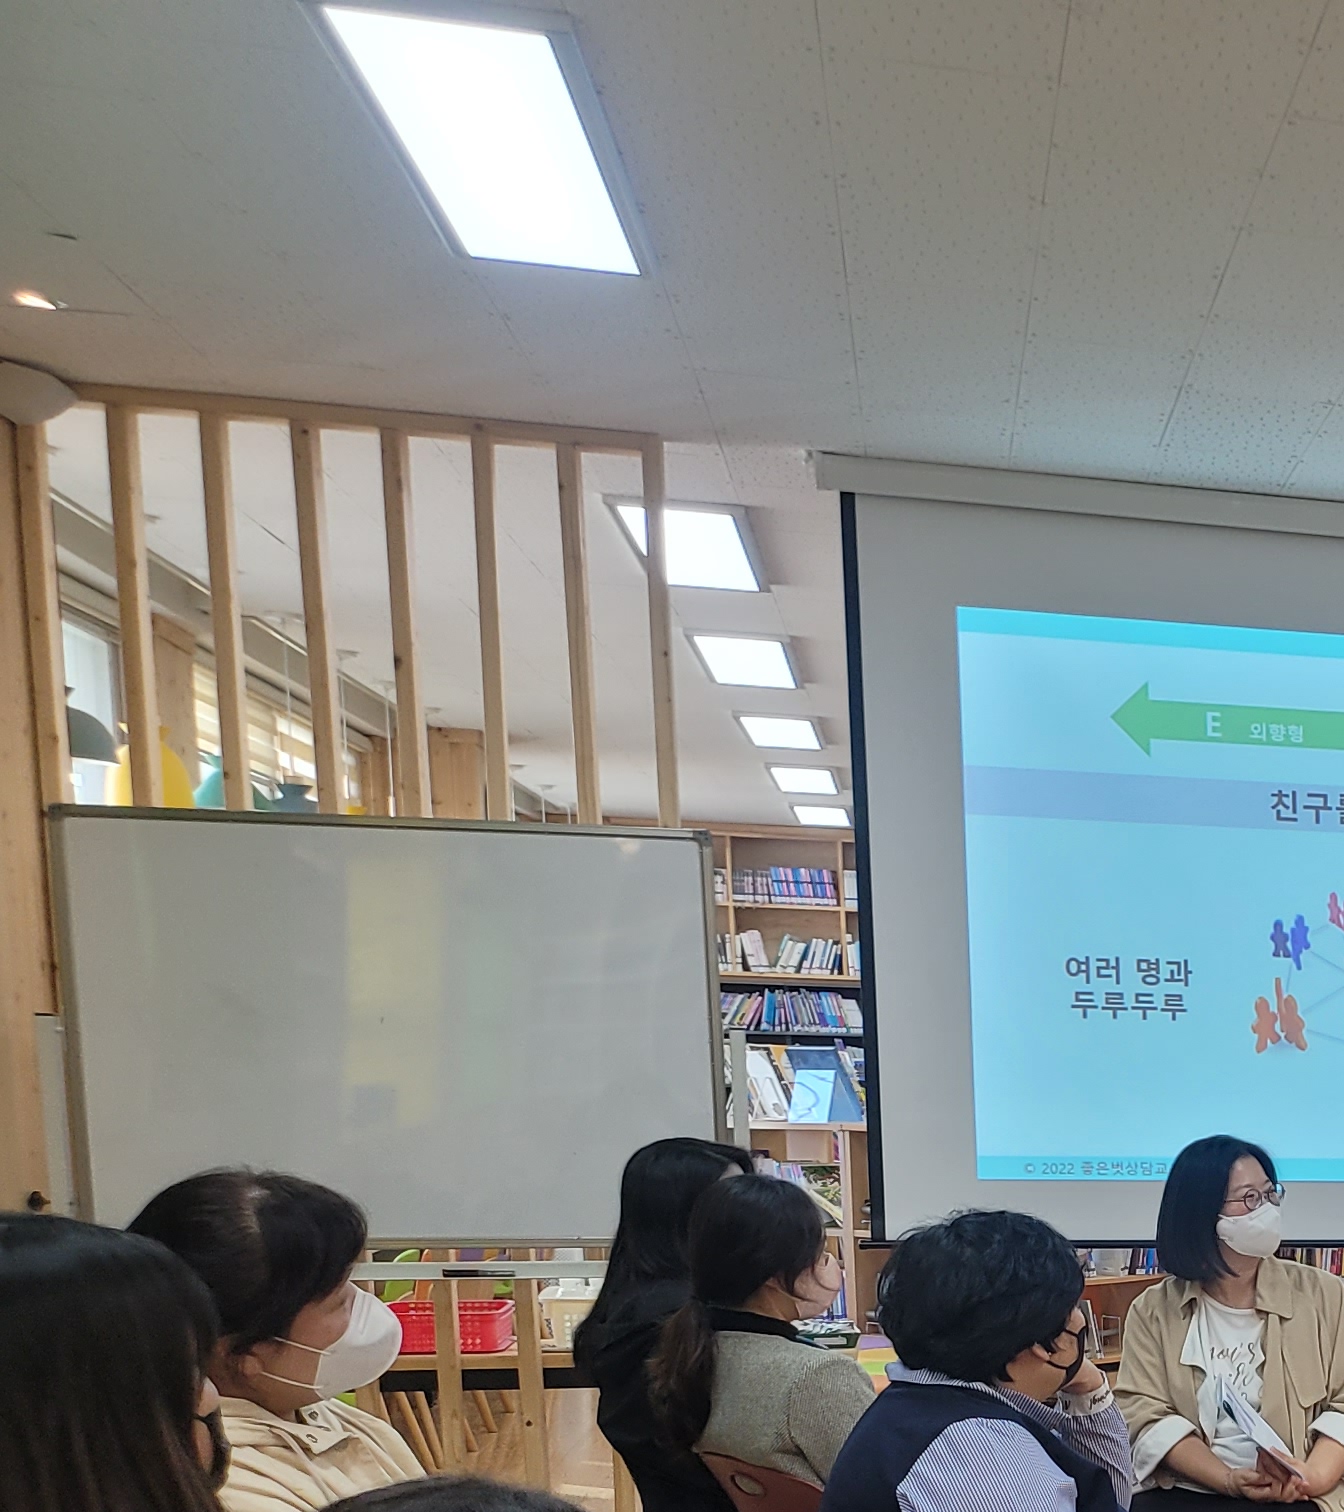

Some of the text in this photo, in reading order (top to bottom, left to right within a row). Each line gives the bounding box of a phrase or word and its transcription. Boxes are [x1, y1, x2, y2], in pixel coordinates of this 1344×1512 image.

[1206, 711, 1223, 737] E
[1249, 722, 1304, 743] 외향형
[1065, 955, 1193, 988] 여러 명과
[1070, 991, 1188, 1022] 두루두루
[1041, 1162, 1075, 1175] 2022
